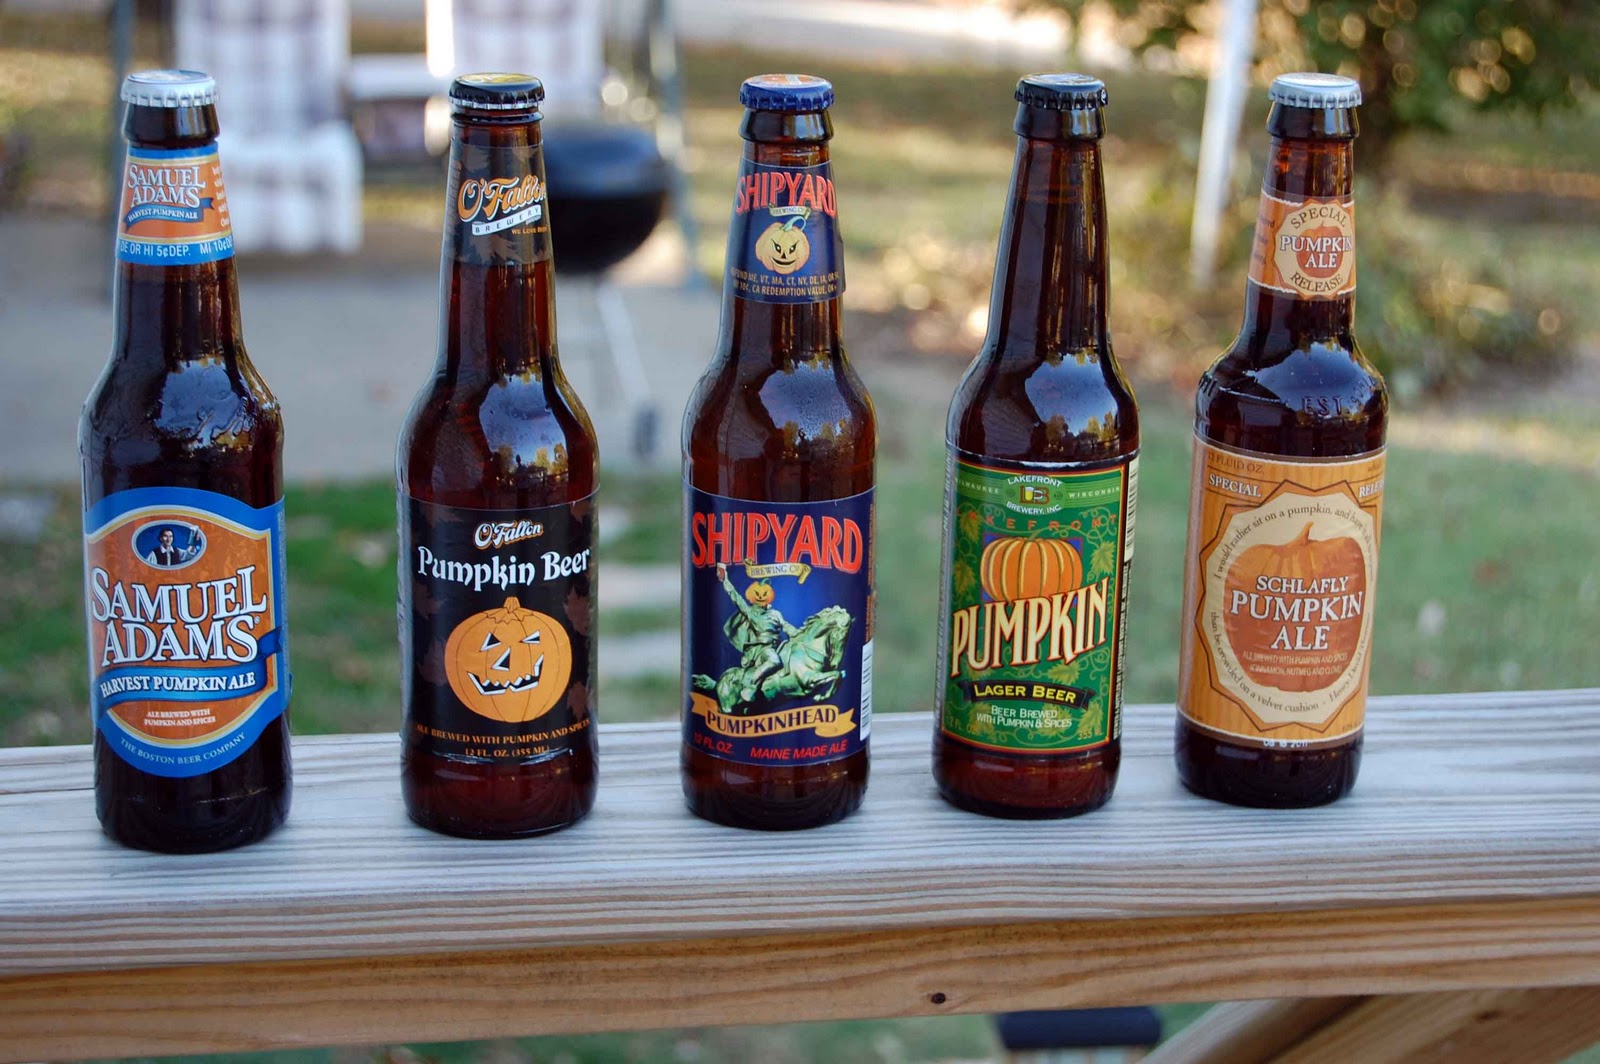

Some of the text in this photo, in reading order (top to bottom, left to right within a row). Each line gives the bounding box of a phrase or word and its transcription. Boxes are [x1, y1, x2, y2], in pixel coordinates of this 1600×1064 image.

[127, 164, 206, 188] SAMUEL
[130, 186, 200, 208] ADAMS
[735, 172, 837, 219] SHIPYARD
[128, 208, 198, 222] HARVEST PUMPKIN ALE
[475, 208, 539, 233] BREWERY
[1290, 206, 1348, 229] SPECIAL
[129, 243, 141, 255] OR
[143, 245, 154, 256] HI
[200, 241, 211, 255] MI
[1280, 235, 1352, 252] PUMPKIN
[1304, 253, 1338, 269] ALE
[761, 285, 806, 297] REDEMPTION
[1290, 272, 1343, 292] RELEASE
[1216, 453, 1245, 469] FLUID
[1007, 475, 1063, 488] LAKEFRONT
[1209, 473, 1261, 497] SPECIAL
[1068, 486, 1120, 499] WISCONSIN
[473, 519, 544, 550] O'Fallon
[691, 511, 864, 575] SHIPYARD
[1217, 543, 1233, 573] would
[1230, 524, 1251, 548] rather
[1252, 516, 1263, 528] sit
[1264, 512, 1277, 522] on
[1279, 510, 1285, 518] a
[1334, 509, 1351, 520] and
[417, 545, 591, 592] Pumpkin Beer
[751, 565, 787, 576] BREWING
[91, 564, 268, 624] SAMUEL
[1256, 575, 1350, 594] SCHLAFLY
[1230, 589, 1363, 623] PUMPKIN
[950, 577, 1110, 679] PUMPKIN
[1210, 611, 1219, 632] than
[101, 614, 258, 667] ADAMS
[1213, 633, 1221, 645] be
[1270, 625, 1331, 651] ALE
[1217, 647, 1244, 684] crowded
[100, 671, 256, 698] HARVEST PUMPKIN ALE
[974, 684, 1077, 704] LAGER BEER
[1239, 682, 1250, 694] on
[190, 708, 211, 717] WITH
[991, 705, 1058, 719] BEER BREWED
[1256, 694, 1283, 711] velvet
[1284, 701, 1319, 713] cushion
[144, 718, 176, 726] PUMPKIN
[707, 708, 837, 734] PUMPKINHEAD
[976, 713, 1072, 729] WITH PUMPKIN & SPICES
[431, 728, 470, 743] BREWED
[472, 735, 500, 745] WITH
[502, 732, 549, 744] PUMPKIN
[550, 727, 568, 739] AND
[120, 732, 246, 765] THE BOSTON BEER COMPANY
[750, 746, 790, 760] MAINE
[792, 745, 827, 759] MADE
[828, 739, 848, 755] ALE
